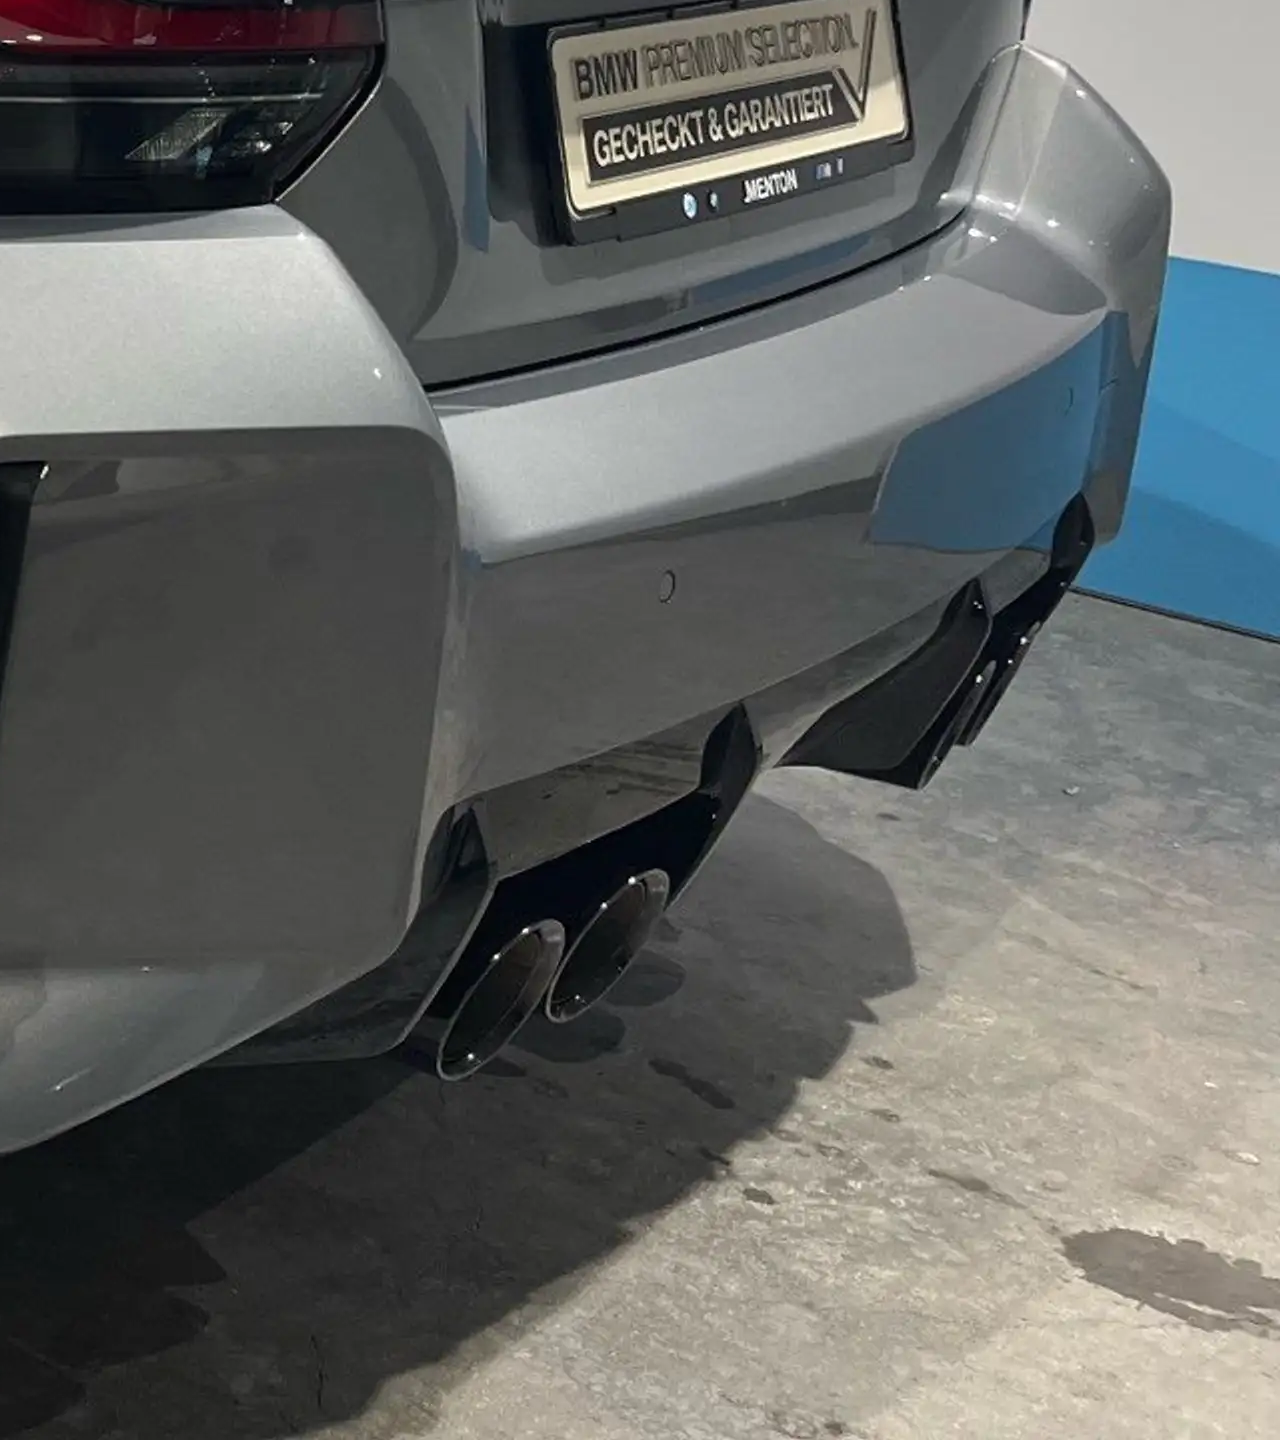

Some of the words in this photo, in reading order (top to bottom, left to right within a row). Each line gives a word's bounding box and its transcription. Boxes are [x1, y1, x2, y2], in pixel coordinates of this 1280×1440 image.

[572, 47, 639, 101] BMW
[643, 28, 747, 89] PREMIUM
[746, 12, 859, 68] SELECTION
[593, 109, 704, 168] GECHECKT
[707, 107, 724, 143] &
[724, 83, 835, 139] GARANTIERT
[743, 168, 798, 203] MENTON
